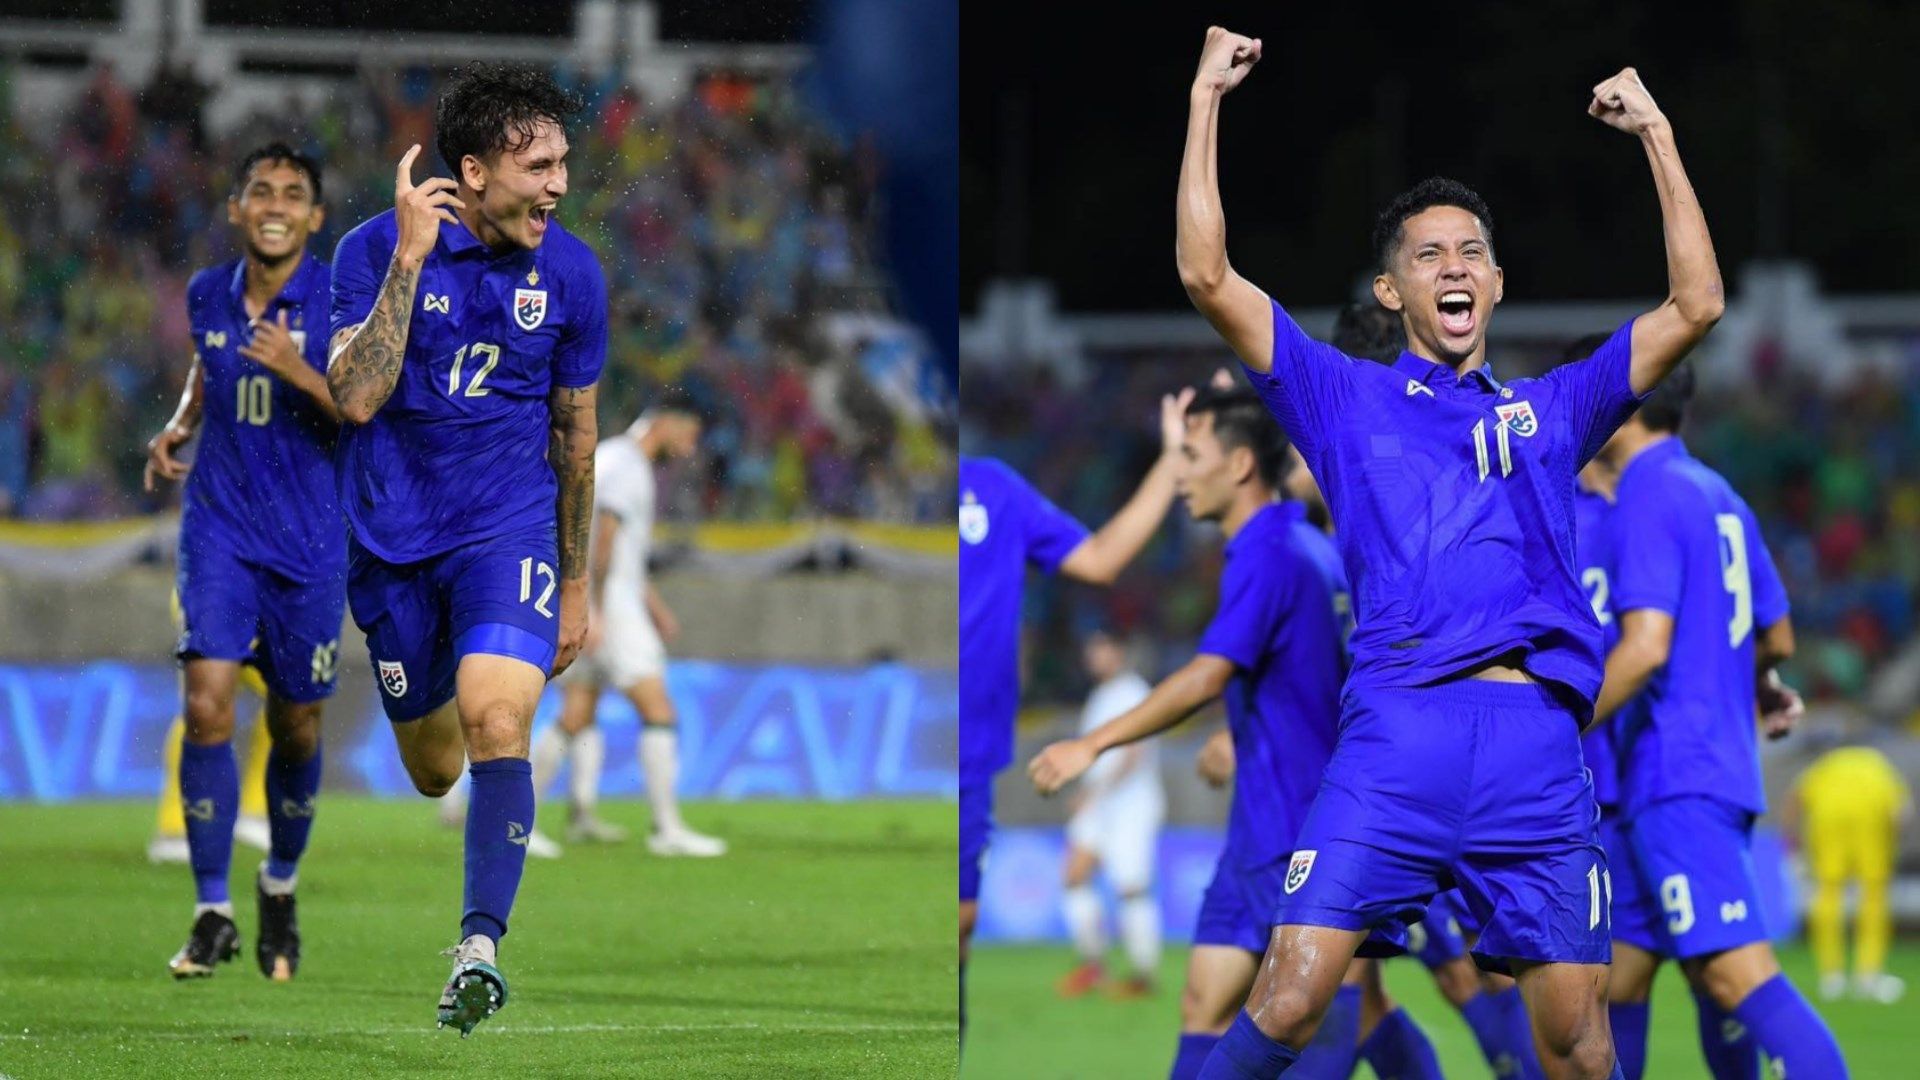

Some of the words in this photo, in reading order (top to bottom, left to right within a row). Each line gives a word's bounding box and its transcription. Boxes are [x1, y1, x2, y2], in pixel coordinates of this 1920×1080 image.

[236, 375, 272, 426] 10
[448, 342, 500, 397] 12
[1471, 417, 1512, 483] 11
[519, 556, 556, 618] 12
[1581, 566, 1613, 626] 2
[1715, 513, 1753, 649] 9
[1586, 863, 1612, 932] 11
[1660, 873, 1695, 936] 9
